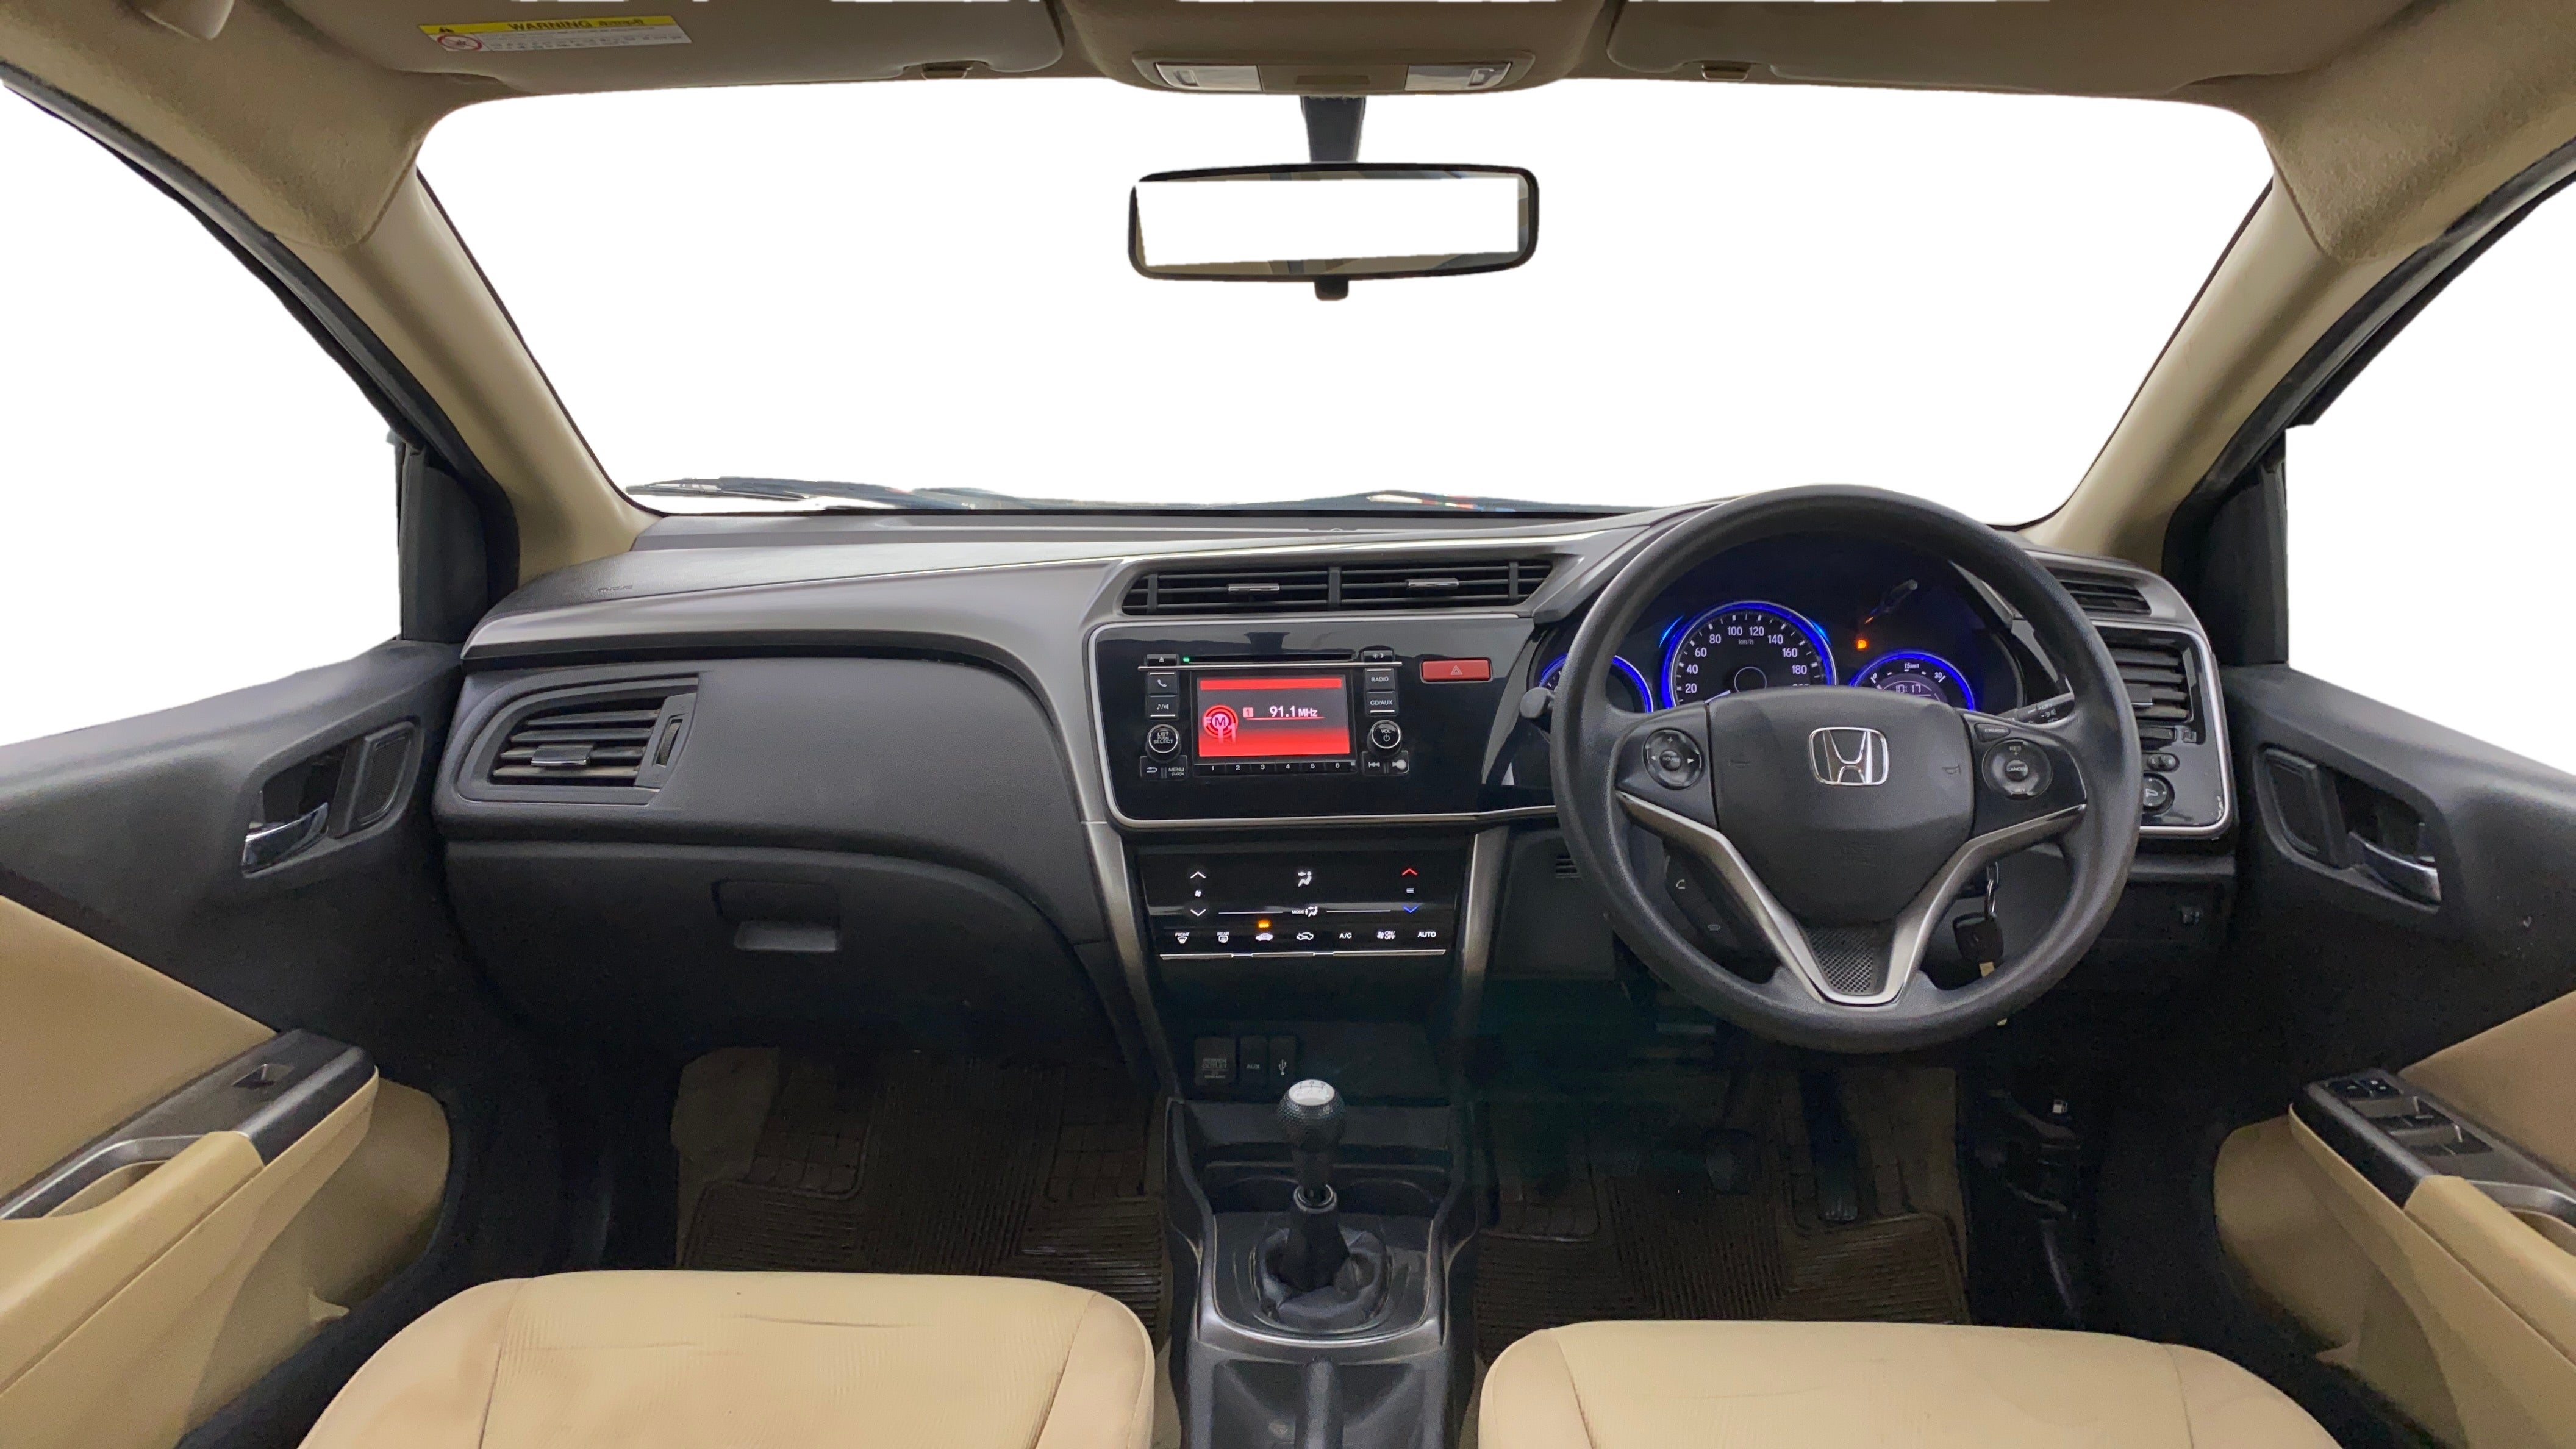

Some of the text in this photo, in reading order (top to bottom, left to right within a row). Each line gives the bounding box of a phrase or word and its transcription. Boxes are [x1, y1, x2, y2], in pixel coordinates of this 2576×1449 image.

[508, 20, 593, 30] WARNING
[1727, 626, 1743, 636] 100
[1749, 626, 1764, 636] 120
[1709, 634, 1721, 644] 80
[1768, 634, 1783, 645] 140
[1695, 648, 1707, 657] 60
[1782, 648, 1798, 657] 160
[1687, 664, 1698, 674] 40
[1792, 664, 1807, 674] 180
[1685, 683, 1697, 693] 20
[1269, 705, 1318, 717] 91.1 MHz
